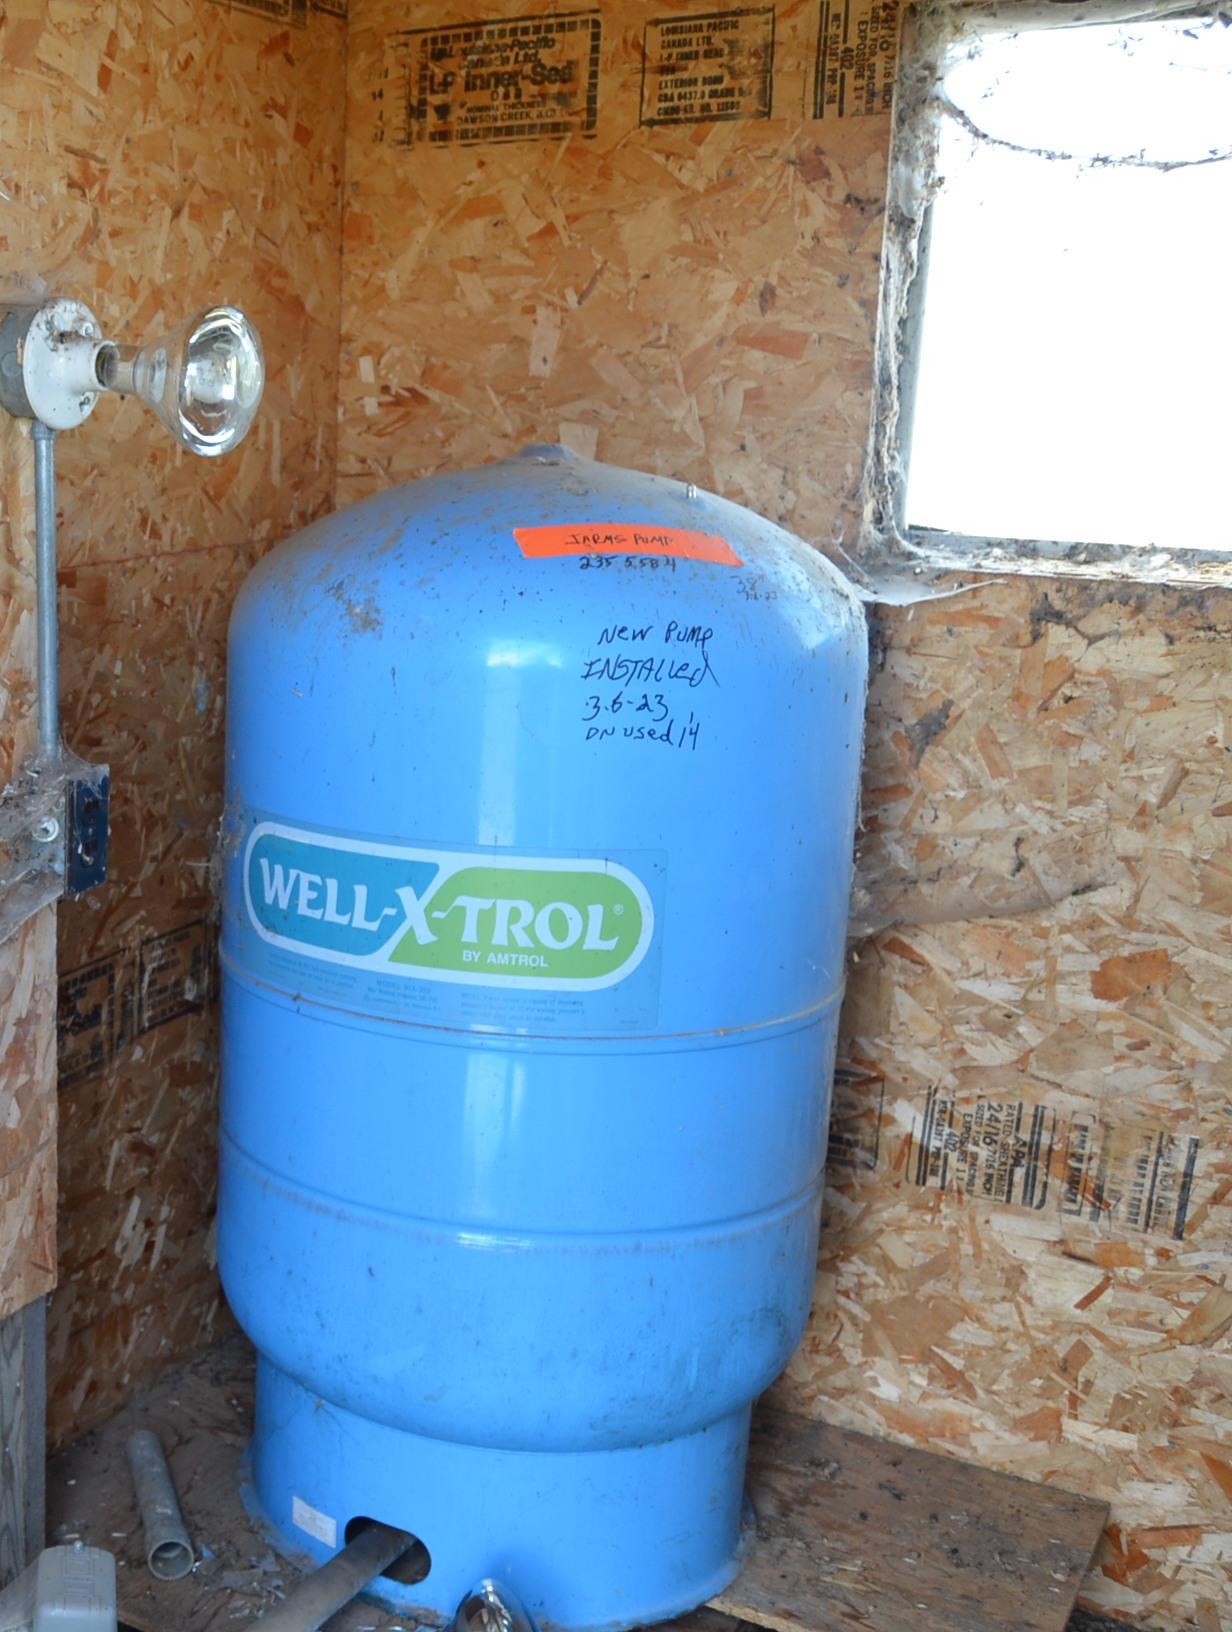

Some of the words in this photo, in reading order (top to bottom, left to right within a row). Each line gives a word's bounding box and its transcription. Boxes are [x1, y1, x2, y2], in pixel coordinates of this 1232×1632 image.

[462, 951, 481, 965] BY
[487, 952, 549, 969] AMTROL
[957, 1113, 973, 1164] EXPOSURE
[983, 1102, 1002, 1146] 24/16
[1002, 1104, 1015, 1139] RATED
[946, 1131, 959, 1152] 402
